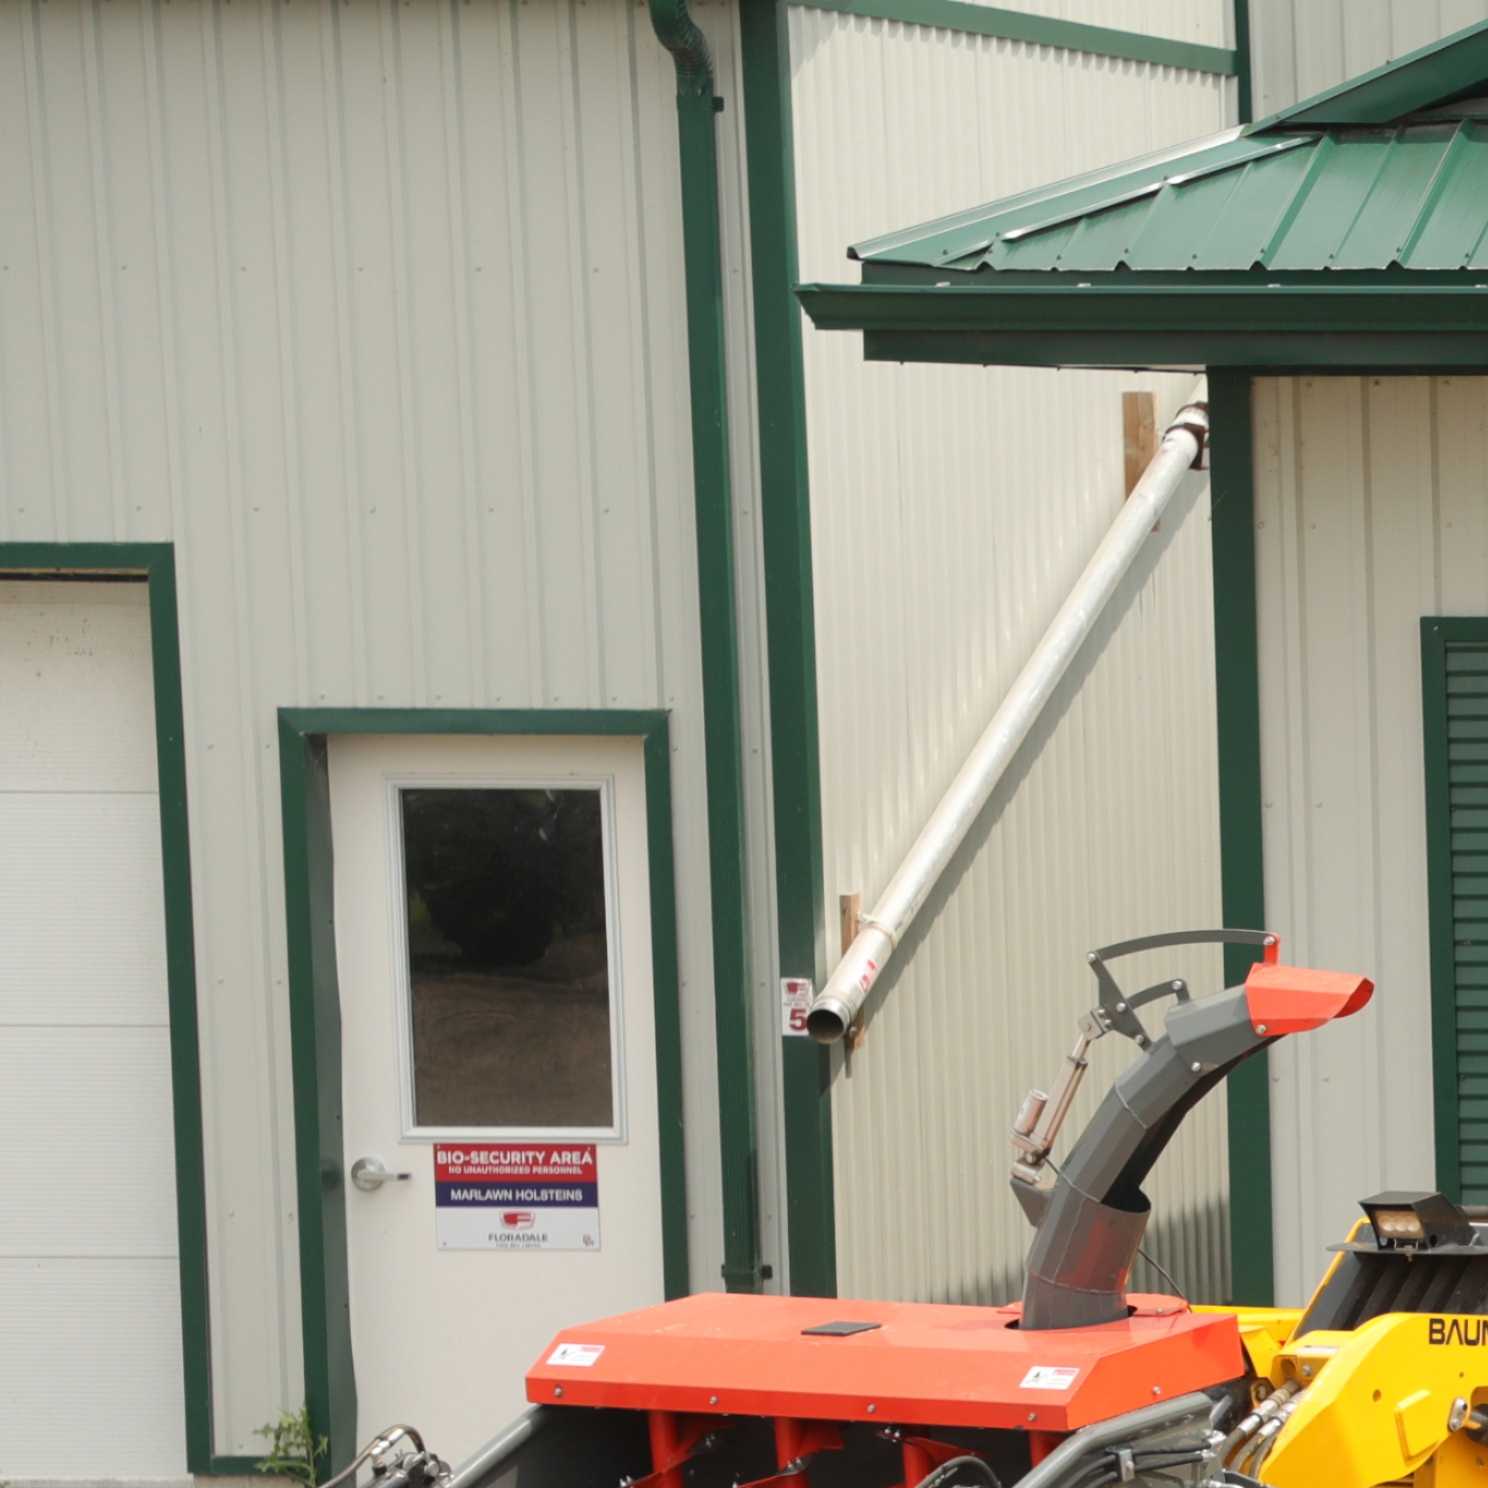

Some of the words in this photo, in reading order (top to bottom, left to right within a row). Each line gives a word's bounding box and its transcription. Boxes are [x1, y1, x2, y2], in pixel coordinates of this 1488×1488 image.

[437, 1150, 545, 1165] BIO-SECURITY
[550, 1150, 593, 1165] AREA
[448, 1165, 462, 1175] NO
[463, 1165, 530, 1175] UNAUTHORIZED
[532, 1165, 583, 1175] PERSONNEL
[450, 1188, 513, 1202] MARLAWN
[515, 1188, 583, 1202] HOLSTEINS
[488, 1232, 549, 1243] FLORADALE
